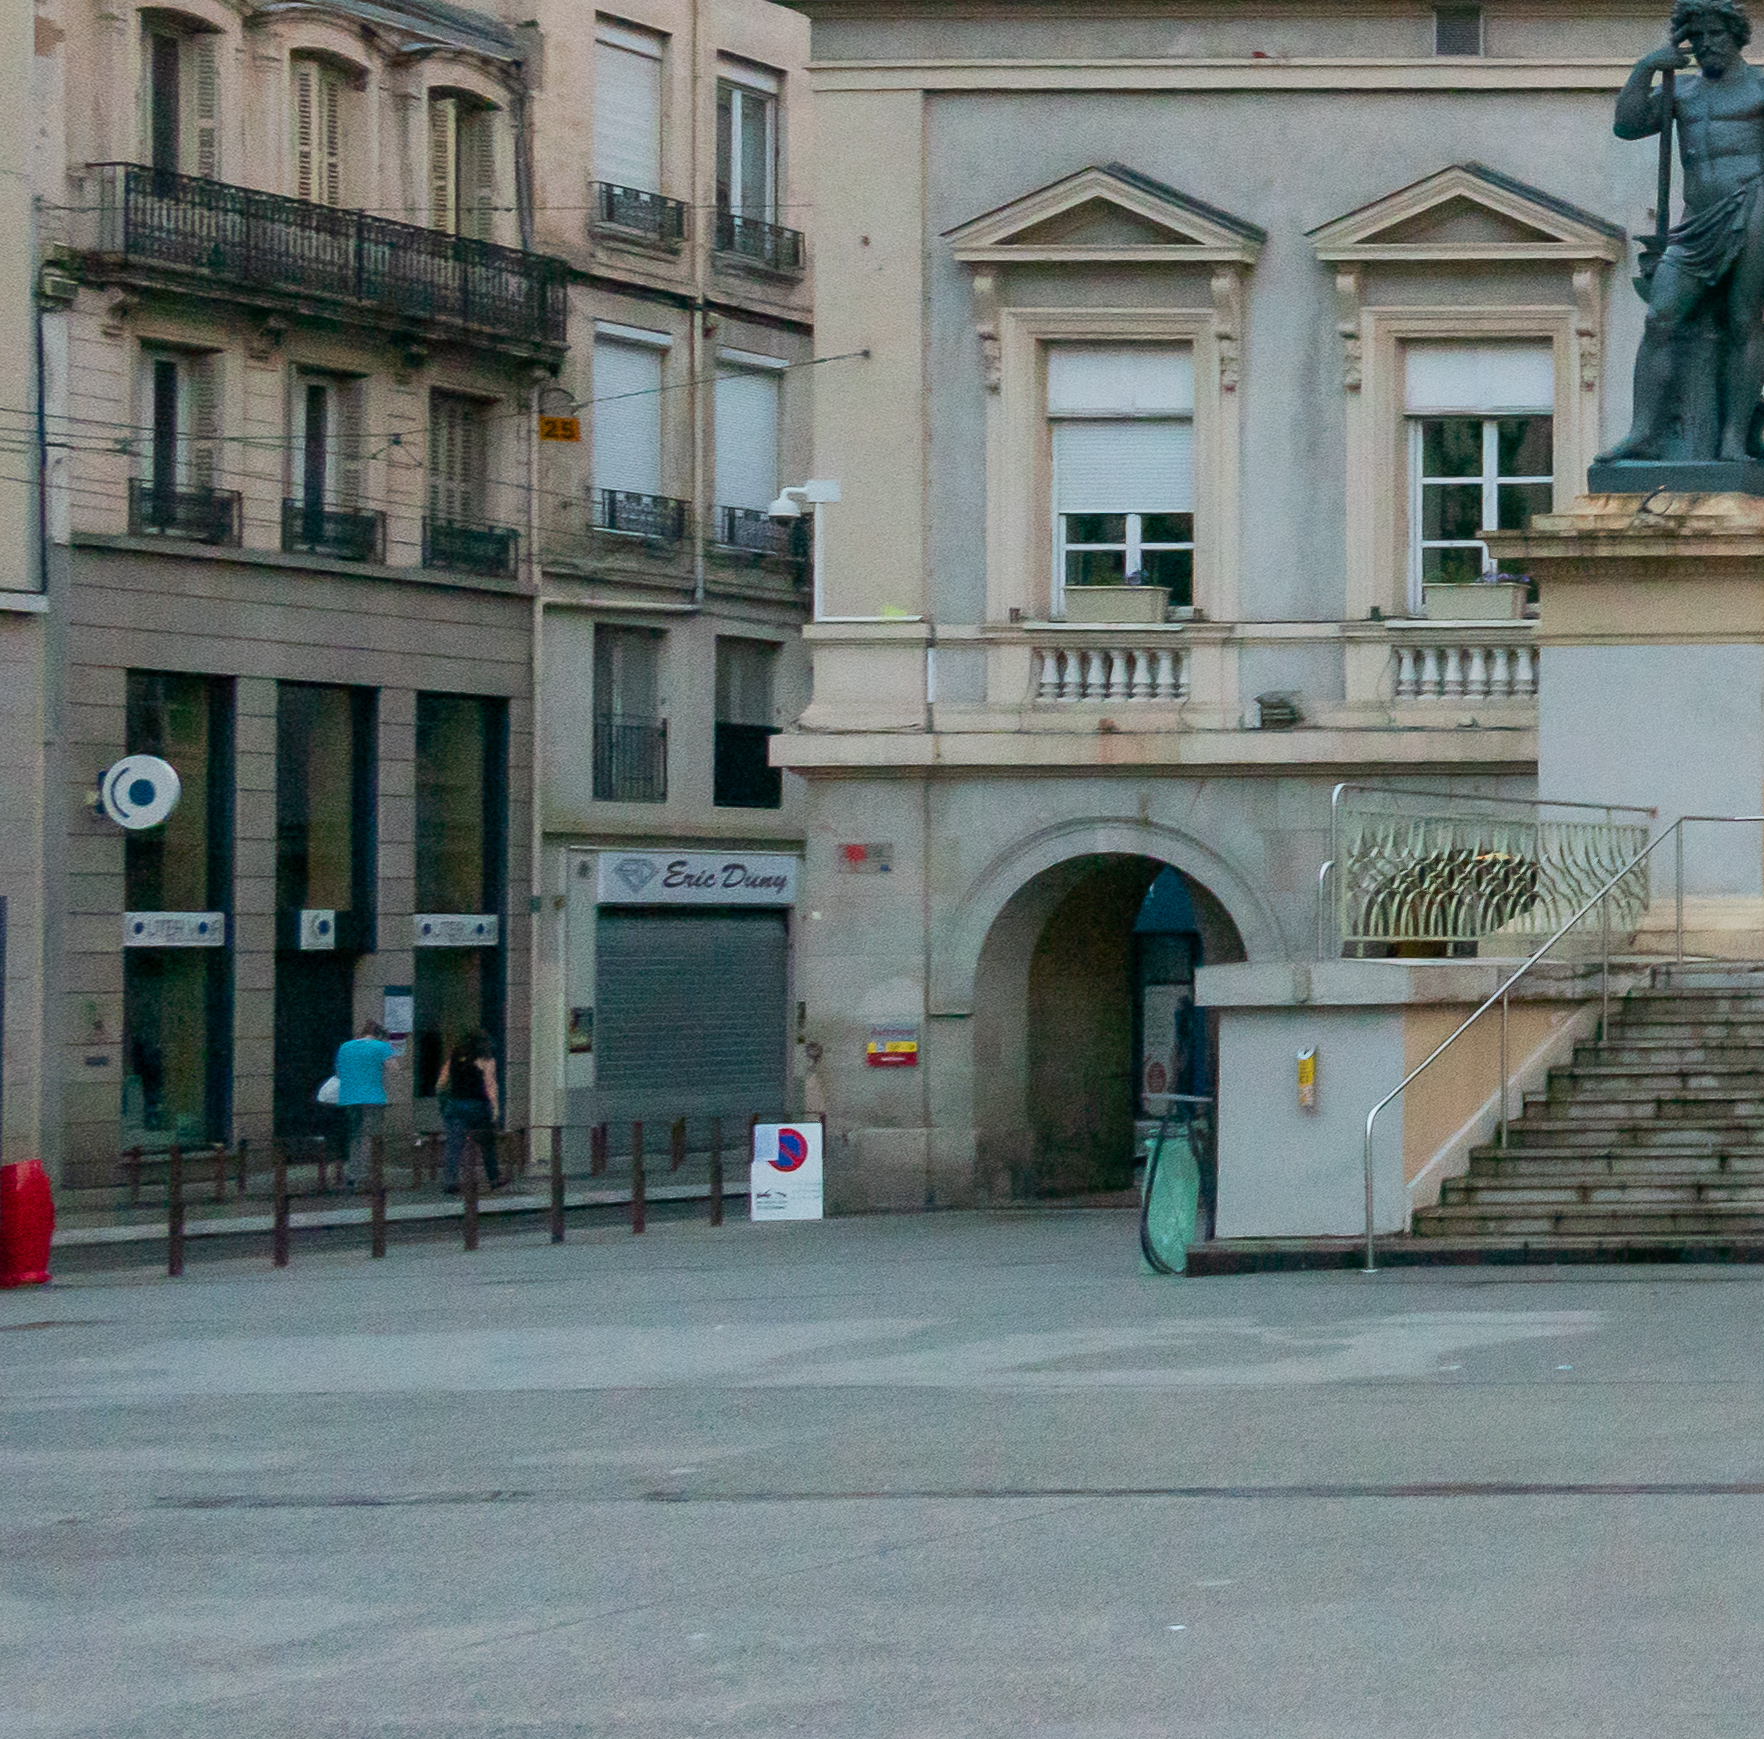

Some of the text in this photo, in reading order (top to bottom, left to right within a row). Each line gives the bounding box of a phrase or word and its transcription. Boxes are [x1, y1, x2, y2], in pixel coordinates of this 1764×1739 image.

[545, 421, 575, 438] 25
[662, 860, 787, 894] Eric Duny
